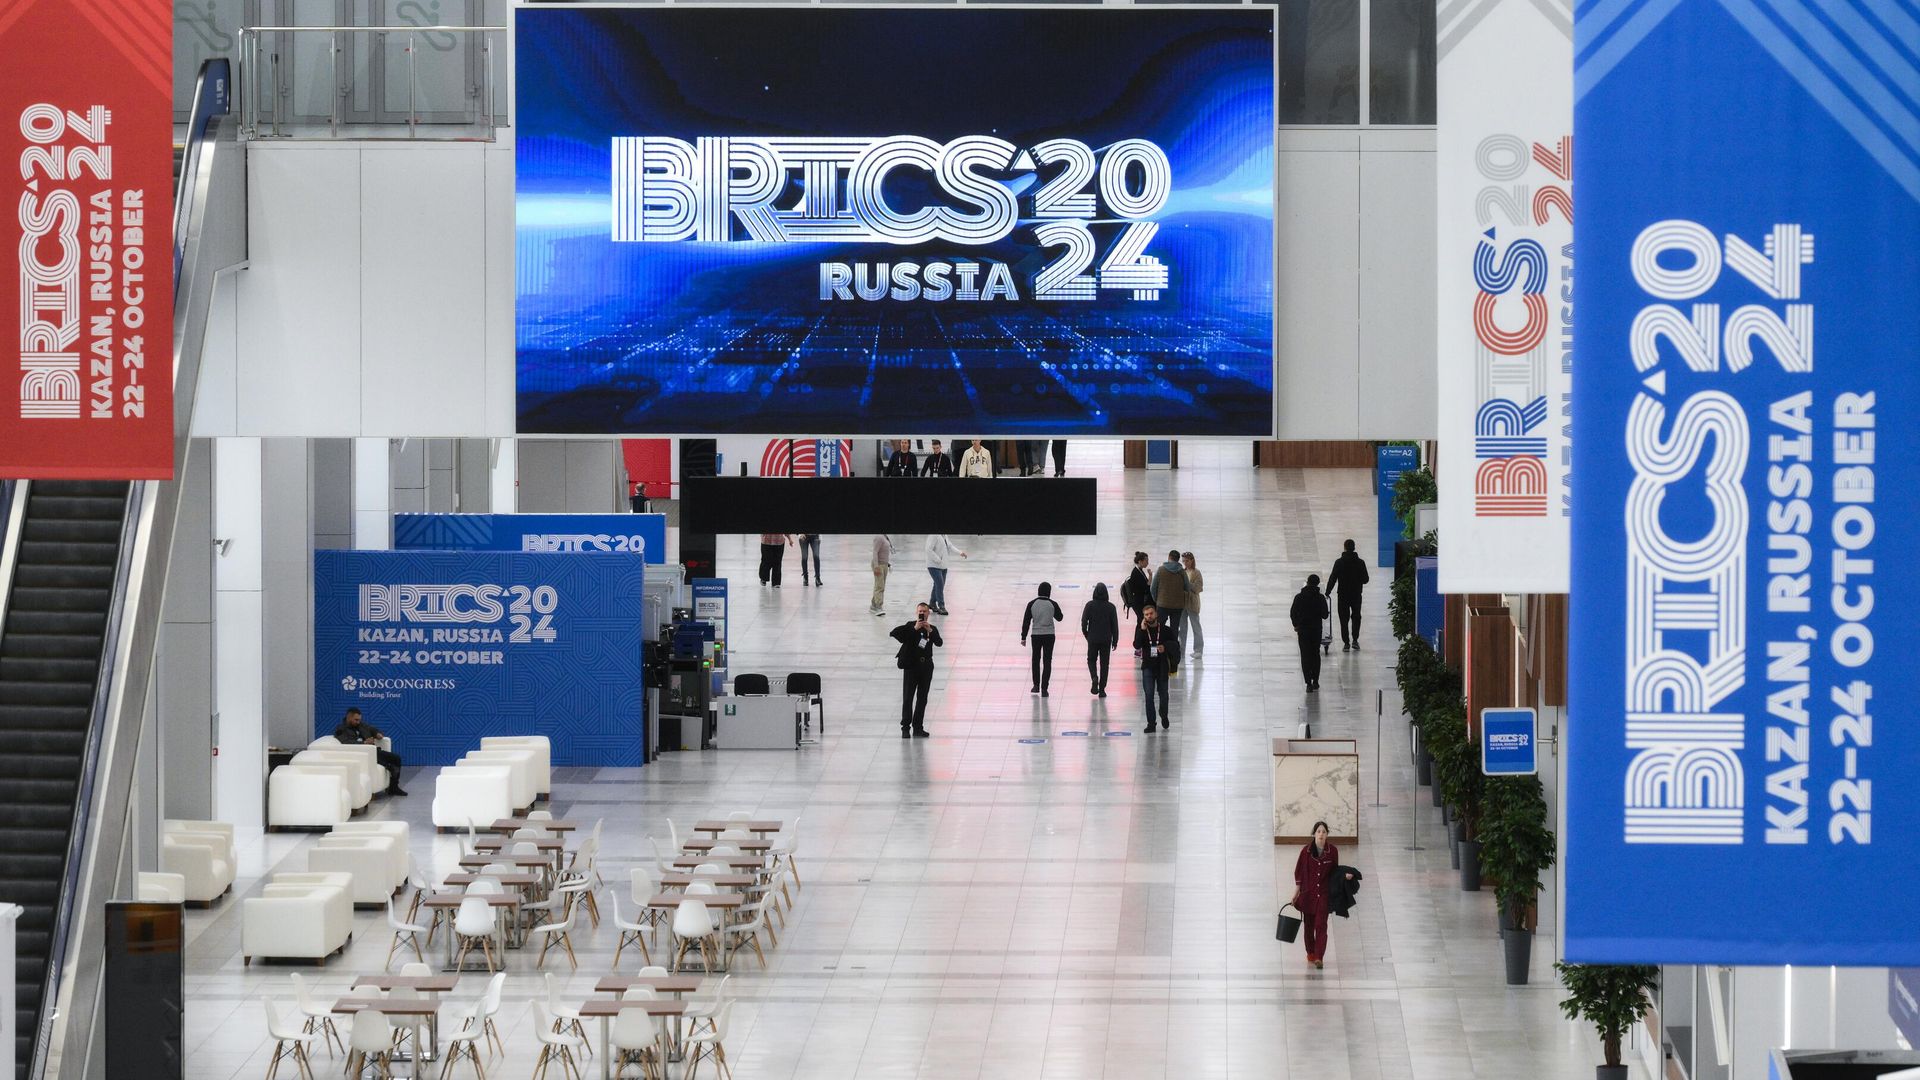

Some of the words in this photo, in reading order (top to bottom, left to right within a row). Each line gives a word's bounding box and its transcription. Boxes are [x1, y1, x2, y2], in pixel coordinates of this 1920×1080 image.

[90, 188, 113, 301] RUSSIA
[611, 135, 1018, 245] BRICS
[18, 188, 81, 418] BRICS
[122, 188, 145, 329] OCTOBER
[819, 262, 1019, 301] RUSSIA
[90, 308, 116, 418] KAZAN,
[1474, 238, 1549, 517] BRICS
[1767, 391, 1813, 612] RUSSIA
[1830, 391, 1876, 667] OCTOBER
[358, 629, 429, 645] KAZAN,
[433, 629, 504, 643] RUSSIA
[359, 584, 504, 623] BRICS
[415, 651, 504, 664] OCTOBER
[1624, 390, 1750, 844] BRICS
[359, 679, 455, 689] ROSCONGRESS
[1765, 626, 1817, 844] KAZAN,
